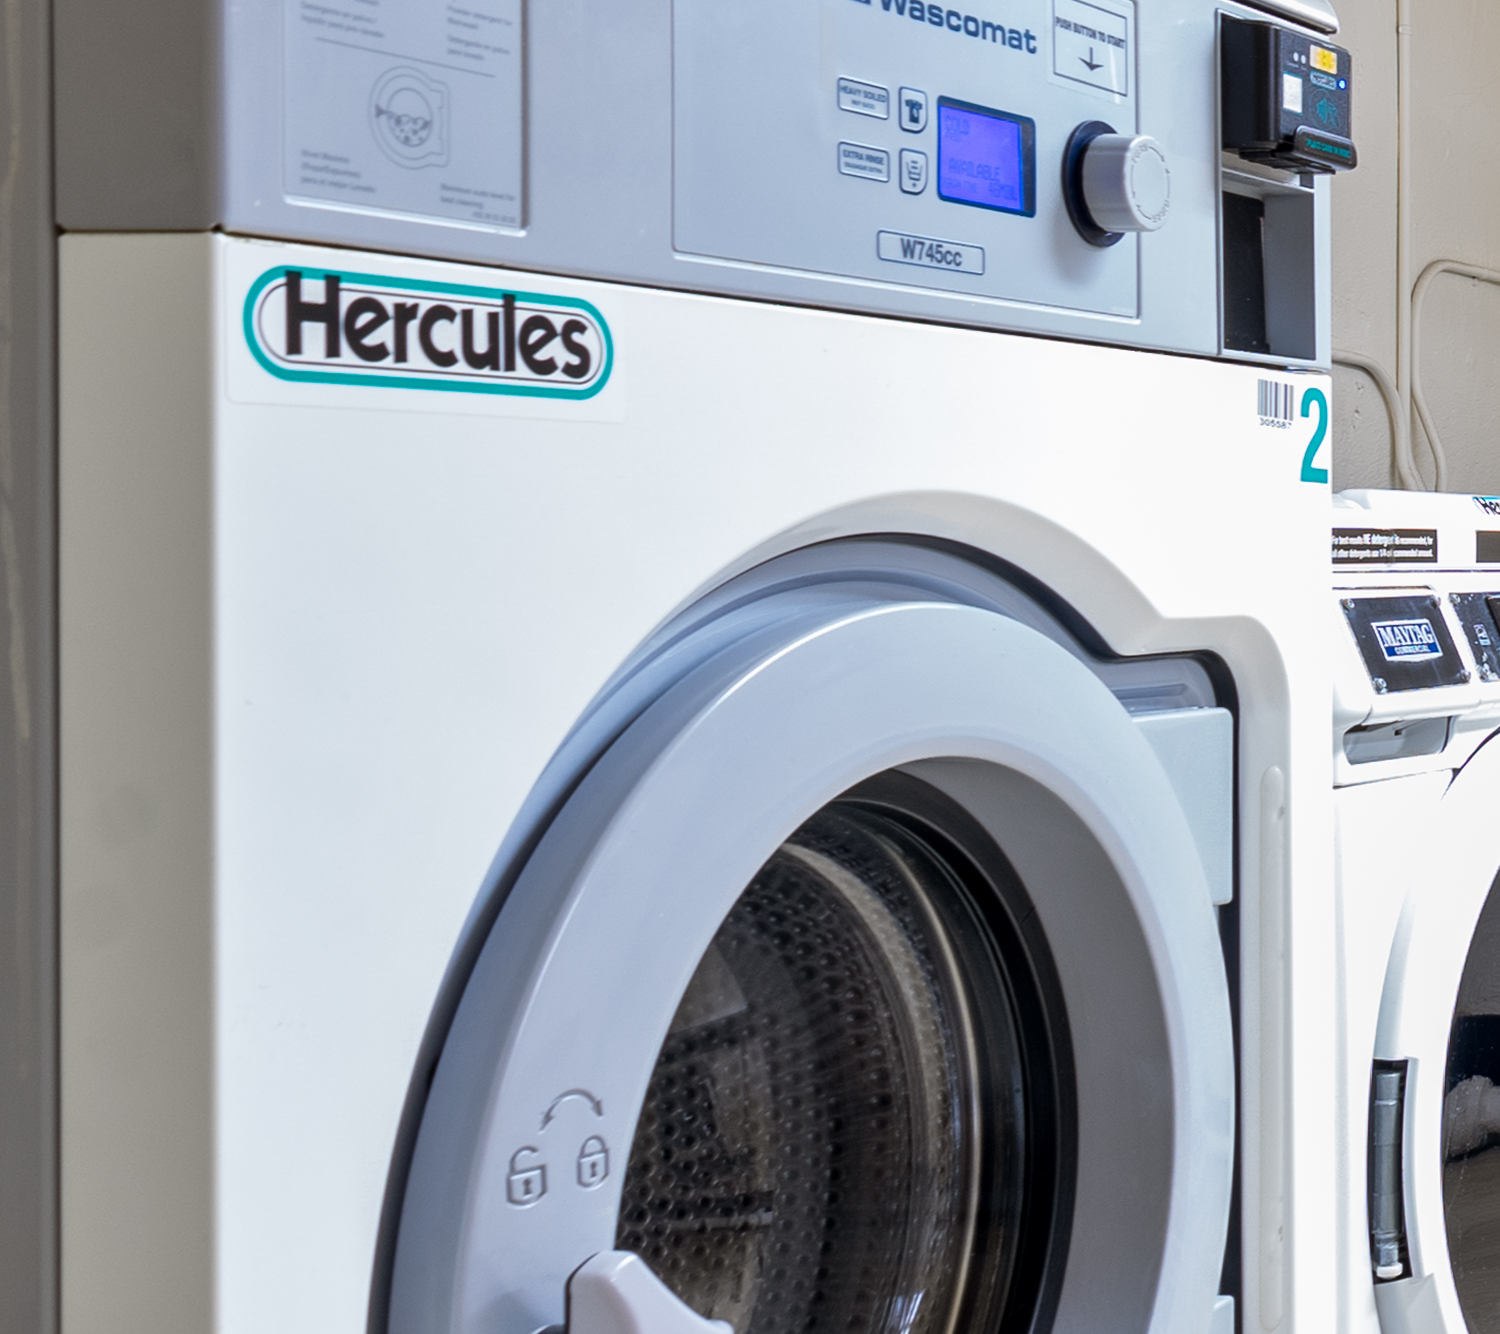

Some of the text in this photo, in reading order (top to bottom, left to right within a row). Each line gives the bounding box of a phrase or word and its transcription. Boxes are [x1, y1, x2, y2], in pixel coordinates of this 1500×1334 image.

[1056, 16, 1125, 49] PUSH BUTTON TO START
[841, 86, 887, 103] HEAVY SOILED
[842, 149, 885, 165] EXTRA RINSE
[901, 239, 962, 267] W745cc
[285, 270, 591, 380] Hercules
[1300, 387, 1328, 484] 2
[1377, 624, 1435, 647] MAYTAG
